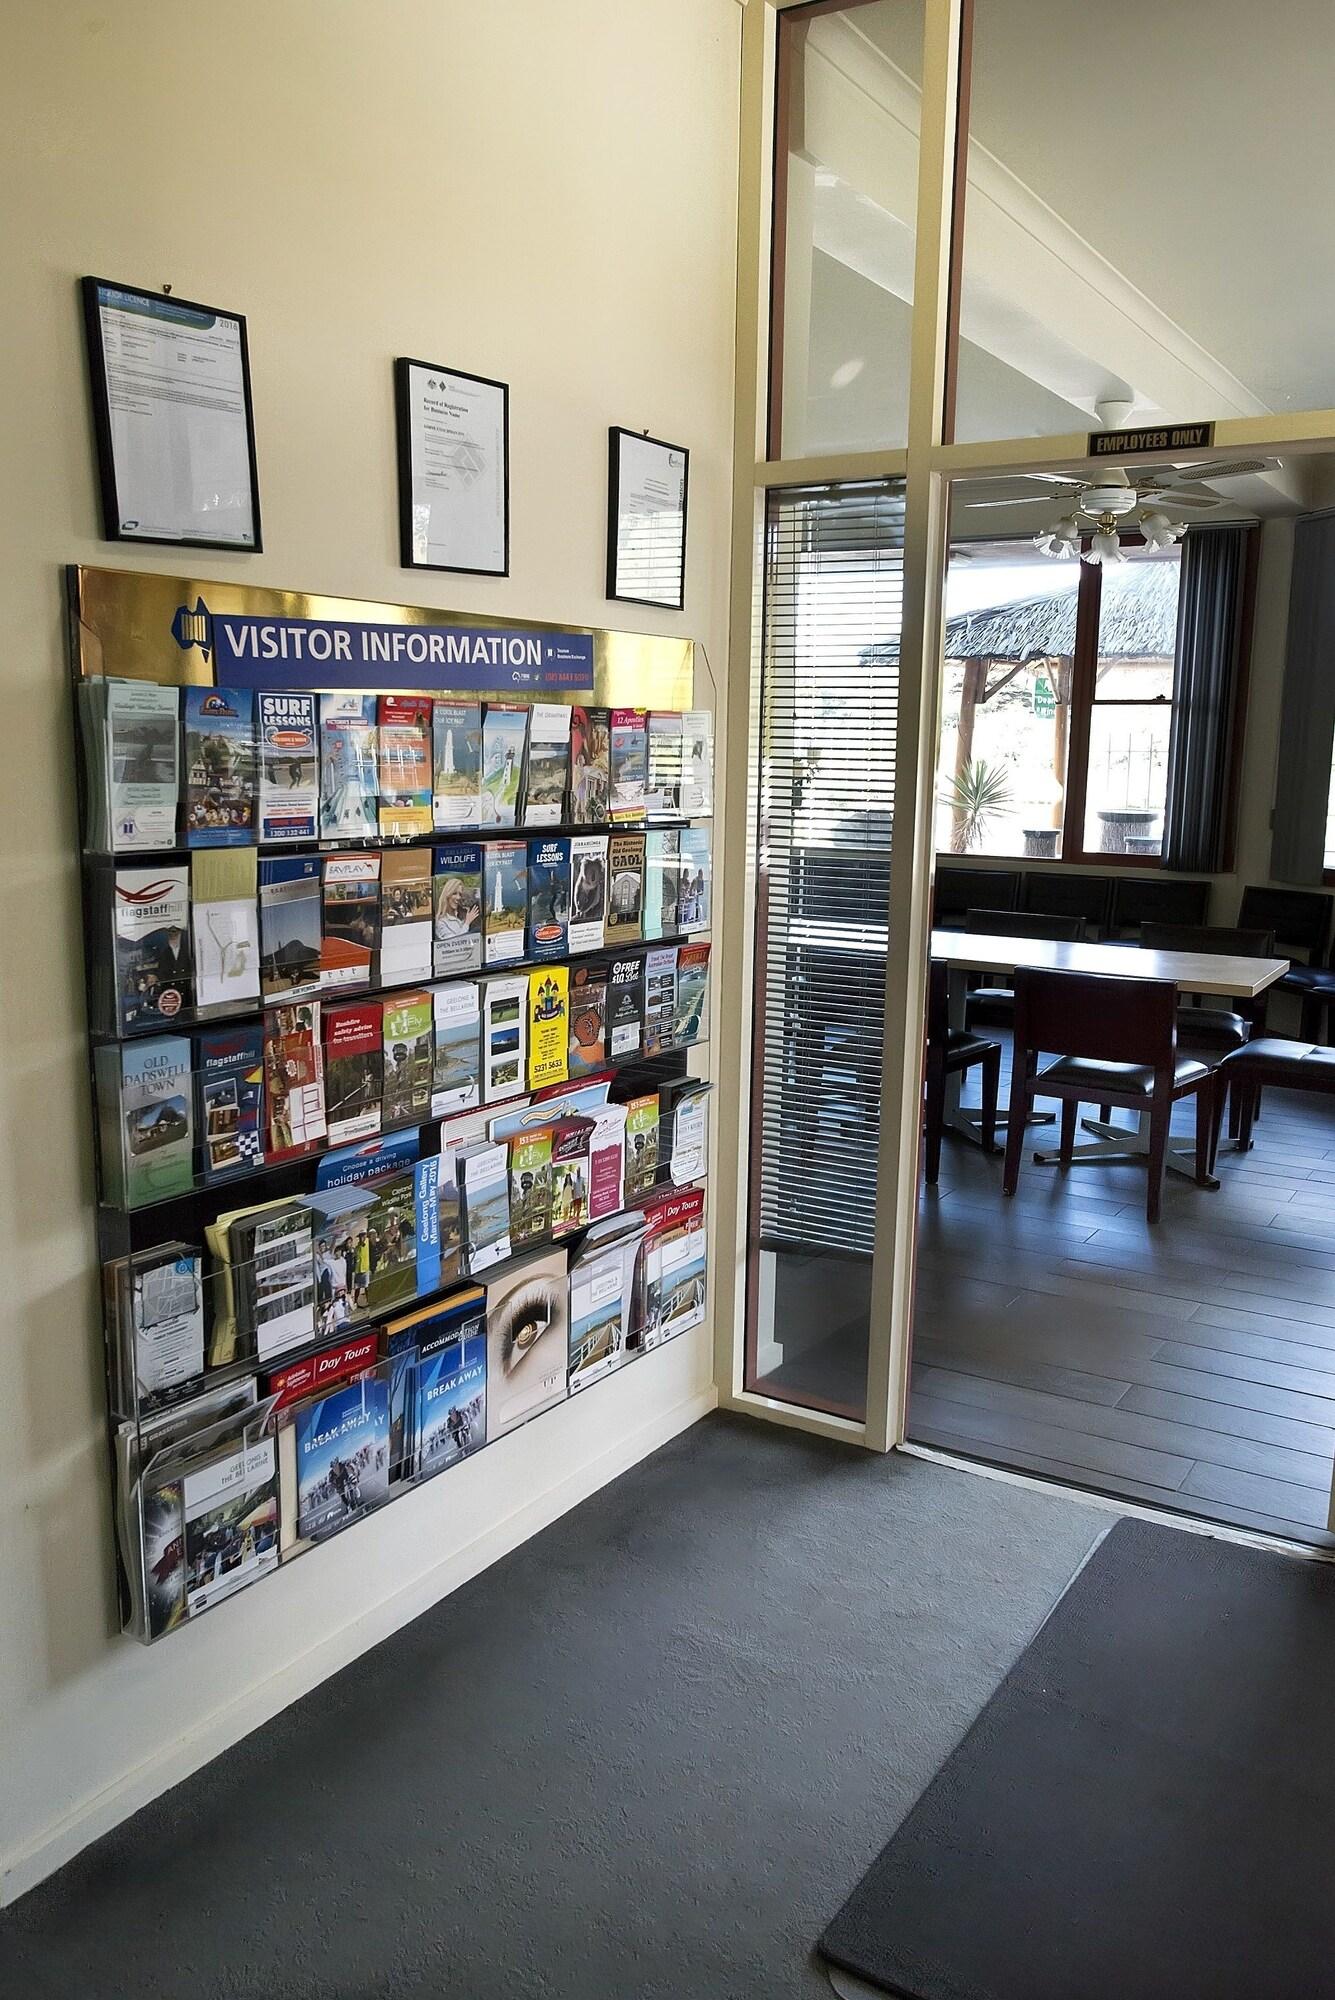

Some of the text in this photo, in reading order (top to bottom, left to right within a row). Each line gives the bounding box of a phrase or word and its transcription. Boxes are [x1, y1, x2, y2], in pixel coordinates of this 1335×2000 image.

[423, 397, 439, 407] Record
[1096, 428, 1204, 453] EMPLOYEES ONLY
[223, 624, 542, 666] VISITOR INFORMATION
[263, 698, 311, 716] SURF
[264, 716, 311, 726] LESSONS
[541, 843, 558, 853] SURF
[440, 853, 476, 865] WILDLIFE
[536, 852, 564, 863] LESSONS
[612, 854, 643, 867] GAOL
[620, 960, 641, 973] FREE
[335, 1019, 361, 1028] Bushfire
[353, 1024, 373, 1032] advice
[143, 1055, 169, 1070] OLD
[124, 1063, 188, 1088] DADSWELL
[140, 1079, 175, 1097] TOWN
[342, 1161, 368, 1173] Choose
[374, 1152, 397, 1165] driving
[327, 1158, 412, 1189] holiday package
[419, 1164, 430, 1242] Geelong Gallery
[667, 1199, 699, 1217] Day Tours
[318, 1344, 372, 1373] Day Tours
[427, 1364, 483, 1401] BREAK AWAY
[221, 1473, 234, 1485] THE
